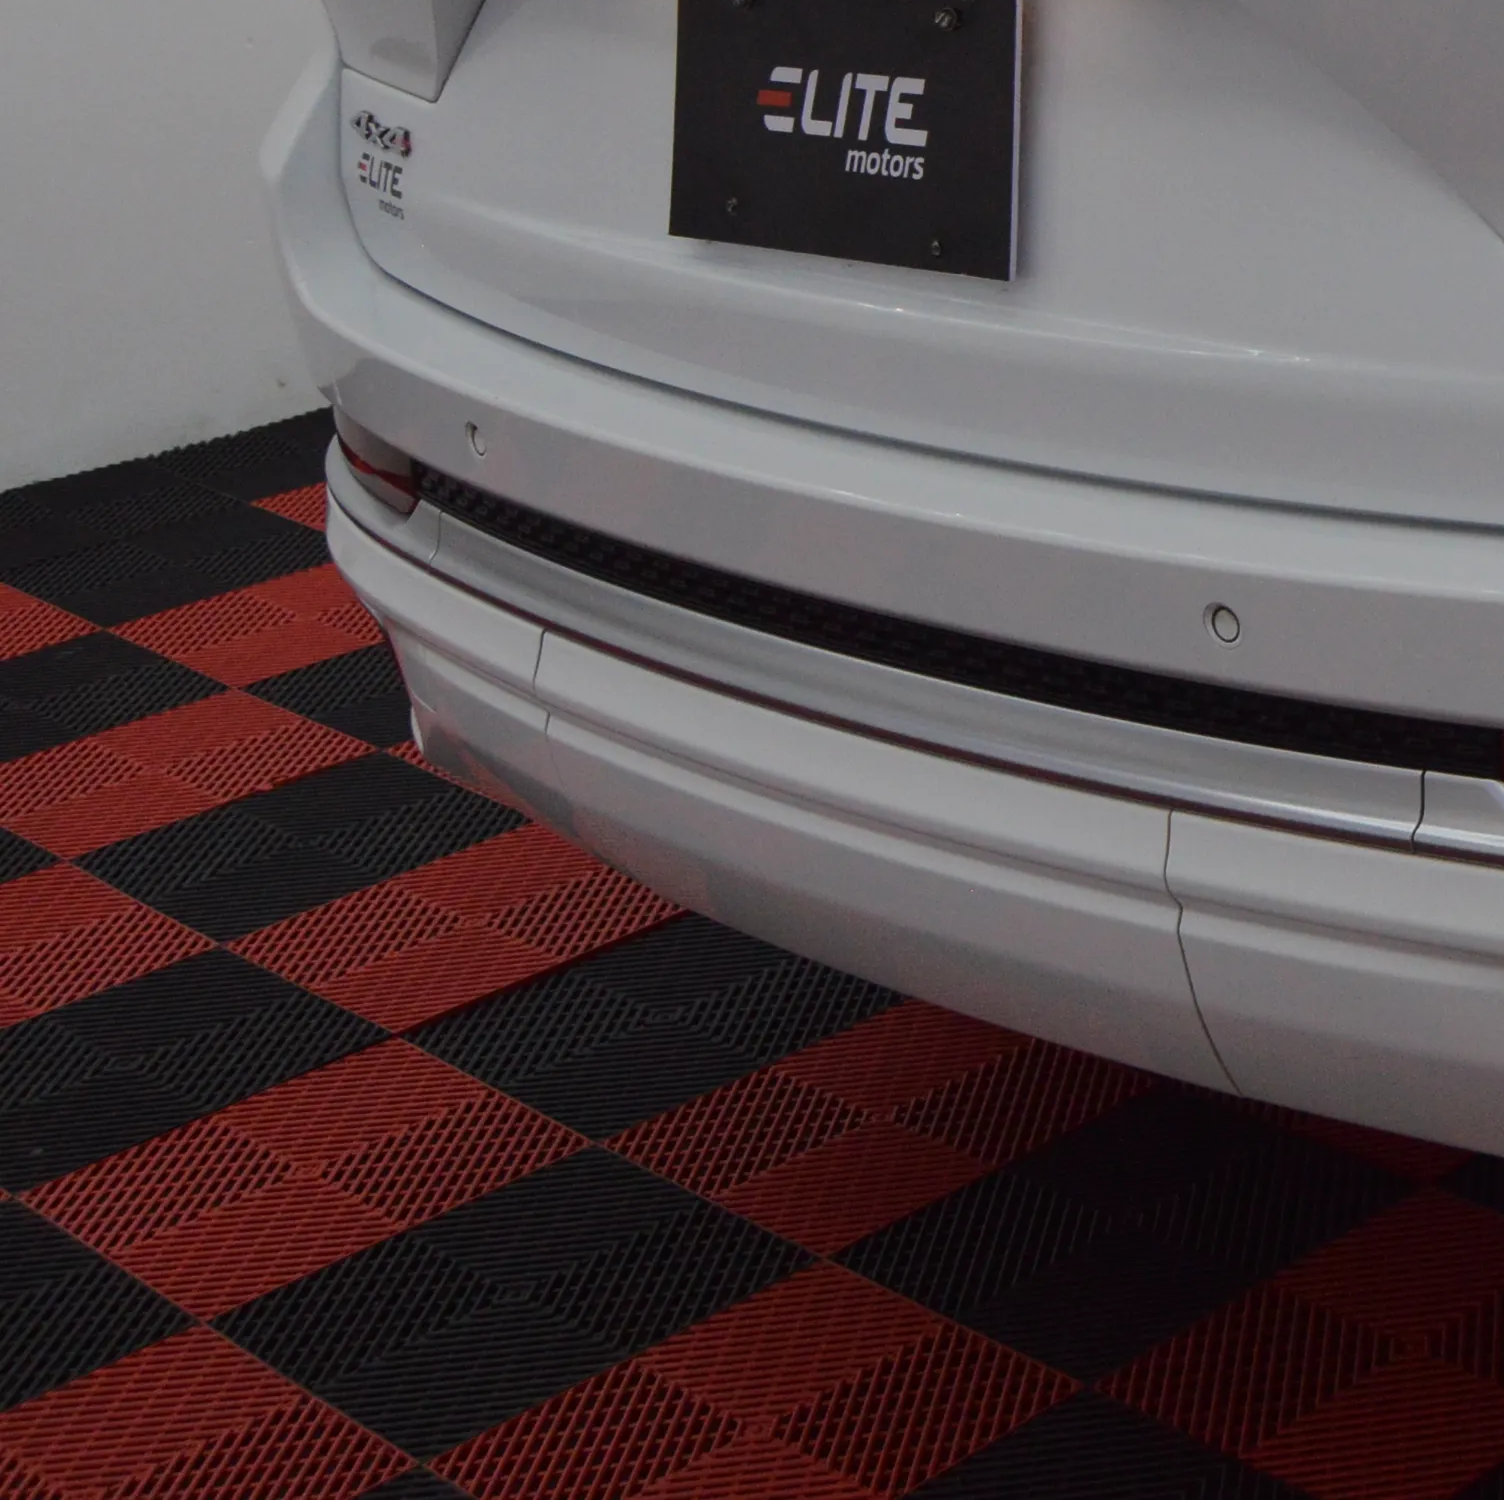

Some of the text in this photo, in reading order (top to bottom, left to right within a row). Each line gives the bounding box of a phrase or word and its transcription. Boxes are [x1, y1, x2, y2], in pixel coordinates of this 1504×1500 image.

[756, 66, 928, 147] ELITE
[357, 152, 403, 199] ELITE
[845, 149, 925, 181] motors
